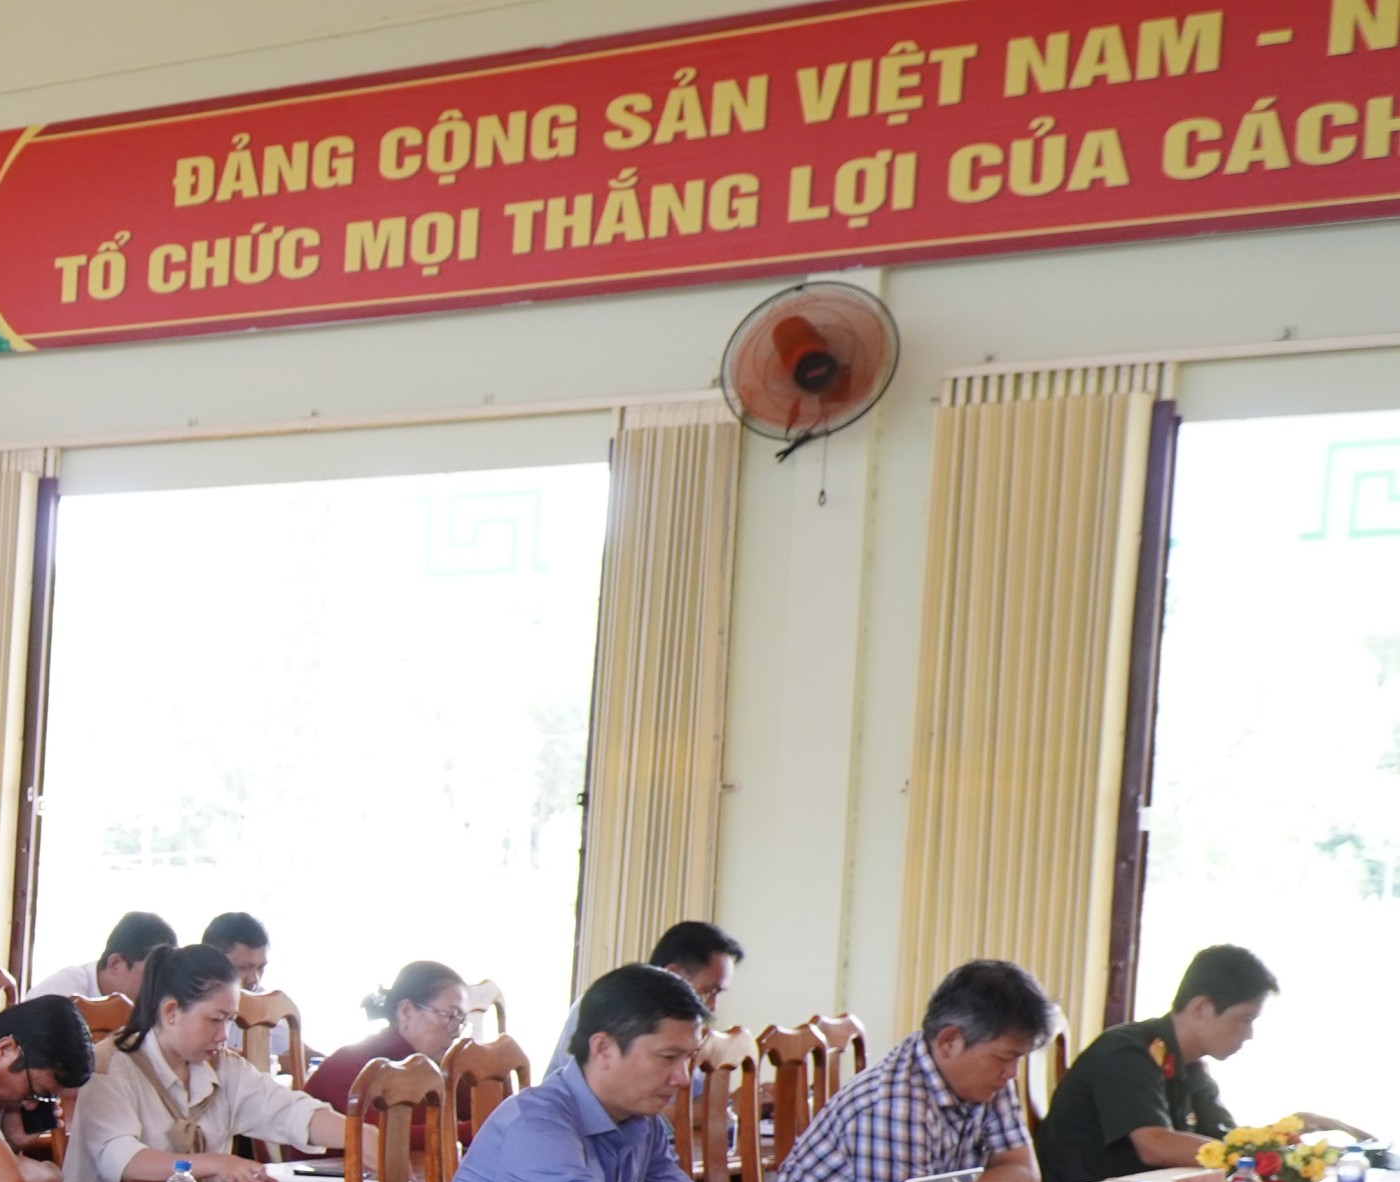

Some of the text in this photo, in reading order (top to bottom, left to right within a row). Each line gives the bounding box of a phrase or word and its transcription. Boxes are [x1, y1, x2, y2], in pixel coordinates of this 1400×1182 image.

[172, 132, 355, 208] ĐẢNG
[379, 105, 578, 186] CỘNG
[603, 68, 768, 151] SẢN
[797, 41, 977, 125] VIỆT
[1005, 12, 1222, 97] NAM
[54, 230, 132, 304] TỔ
[146, 222, 321, 294] CHỨC
[344, 208, 480, 277] MỌI
[503, 167, 760, 257] THẮNG
[788, 150, 917, 229] LỢI
[948, 117, 1130, 205] CỦA
